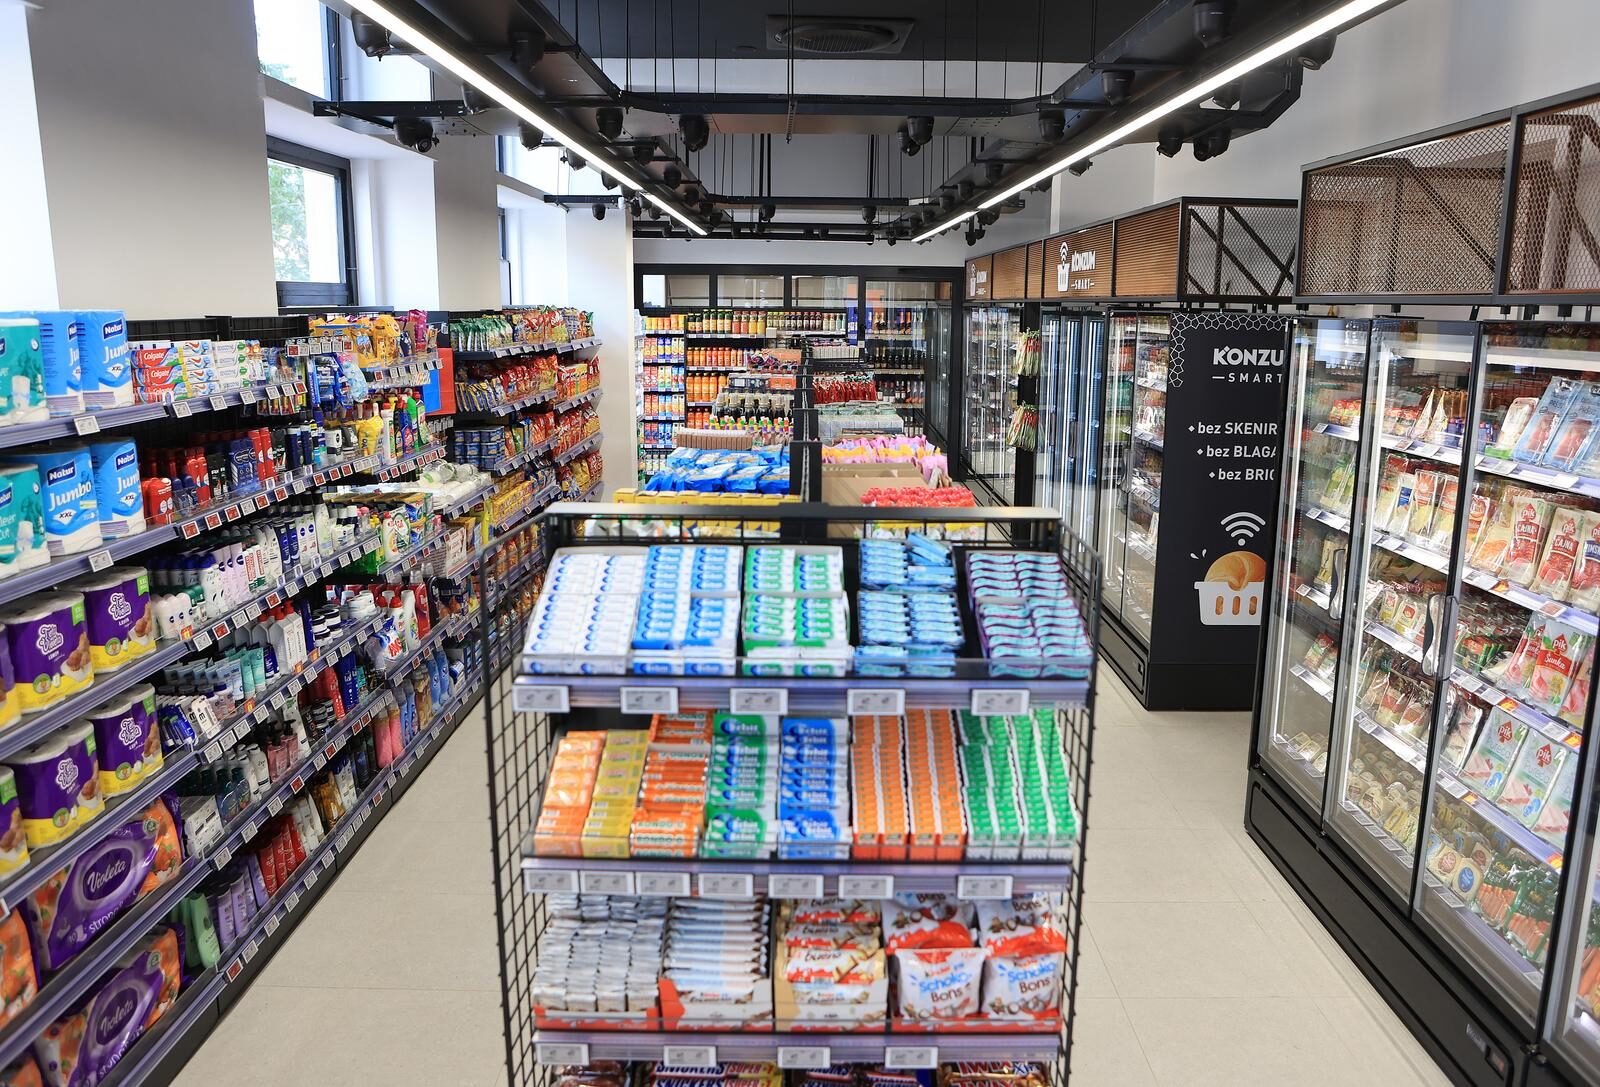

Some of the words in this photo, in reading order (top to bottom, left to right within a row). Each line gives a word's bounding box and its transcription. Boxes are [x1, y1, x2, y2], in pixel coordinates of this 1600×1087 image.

[1072, 251, 1096, 272] KONZUM
[1074, 278, 1091, 290] SMART
[104, 324, 122, 335] Natur
[143, 350, 165, 362] Colgate
[150, 369, 170, 380] Colgate
[1197, 421, 1221, 434] bez
[1206, 445, 1230, 457] bez
[117, 454, 135, 465] Natur
[49, 466, 75, 480] Natur
[1218, 468, 1242, 481] bez
[48, 480, 92, 512] Jumbo
[59, 510, 73, 518] XXL
[1553, 639, 1567, 651] pik
[87, 860, 126, 893] Violeta
[1007, 963, 1056, 984] Schoko
[1019, 976, 1050, 993] Bons
[930, 987, 962, 1003] Bons
